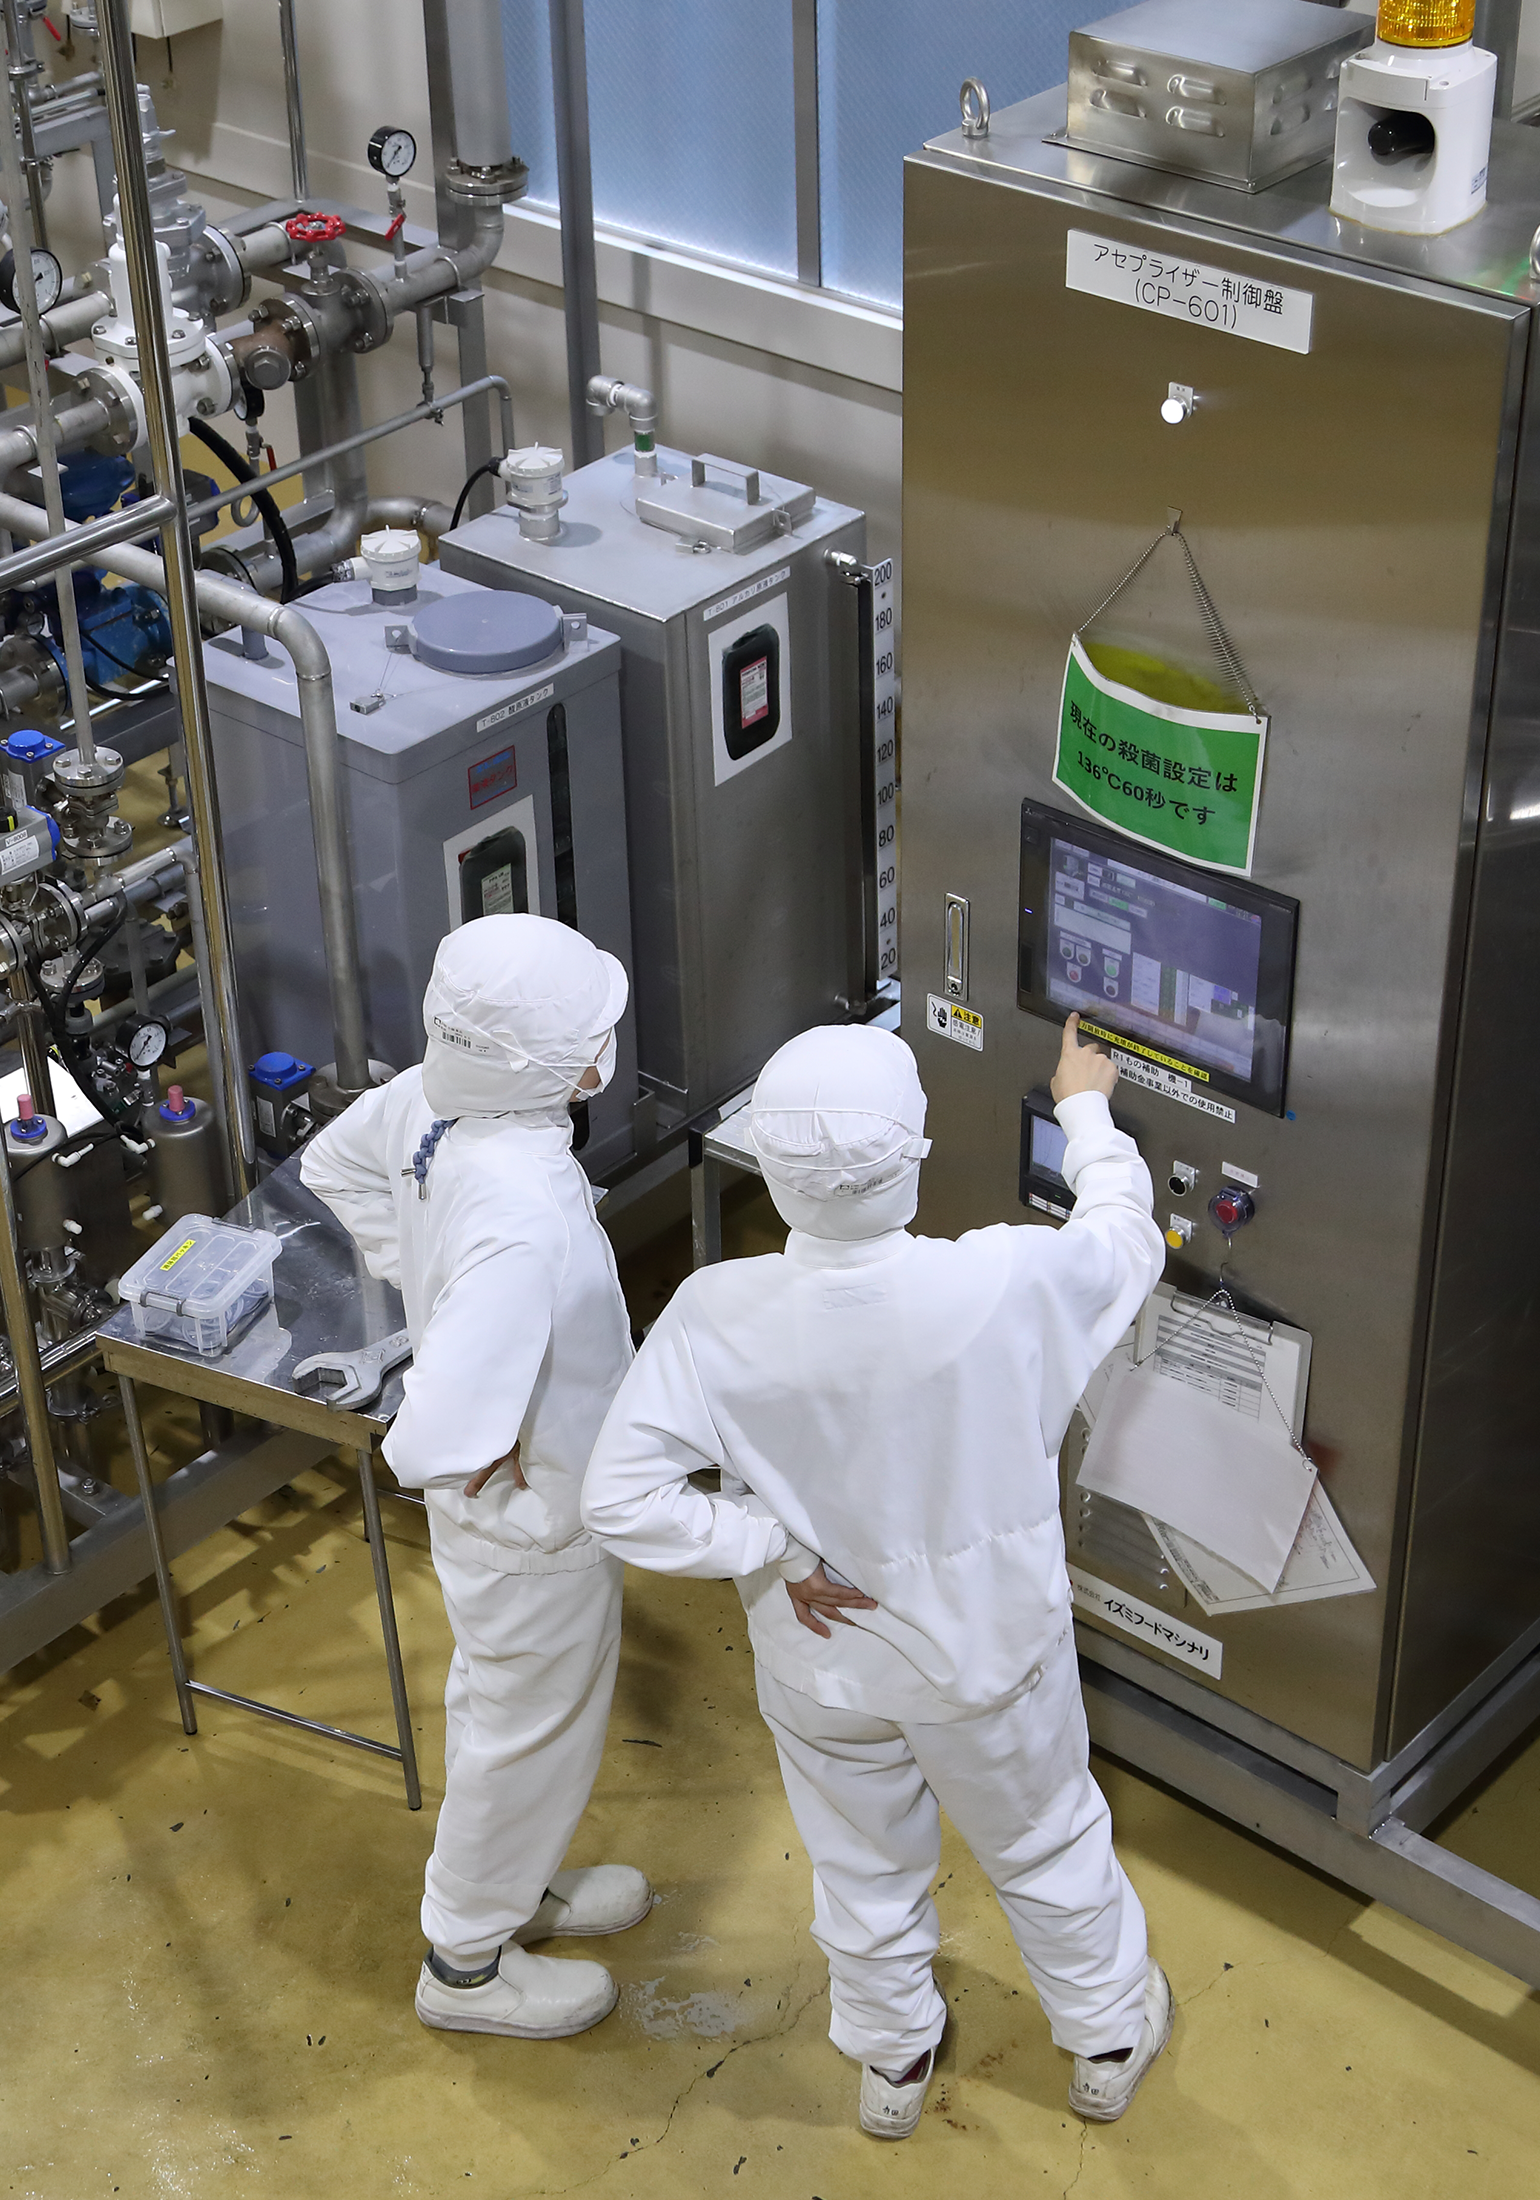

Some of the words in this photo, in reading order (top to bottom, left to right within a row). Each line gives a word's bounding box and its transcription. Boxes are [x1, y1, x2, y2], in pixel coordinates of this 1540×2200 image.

[1093, 243, 1284, 315] アセプライザー制御盤
[1135, 278, 1238, 329] (CP-601)
[875, 561, 892, 586] 200
[876, 607, 892, 631] 180
[876, 652, 892, 676] 160
[877, 696, 893, 720] 140
[877, 739, 893, 763] 120
[1070, 700, 1238, 792] 現在の殺菌設定は
[877, 782, 894, 805] 100
[1077, 751, 1216, 825] 136℃60秒です
[878, 824, 895, 848] 80
[879, 866, 895, 888] 60
[880, 907, 896, 928] 40
[881, 948, 896, 970] 20
[1104, 1599, 1210, 1660] イズミフードマシナリ
